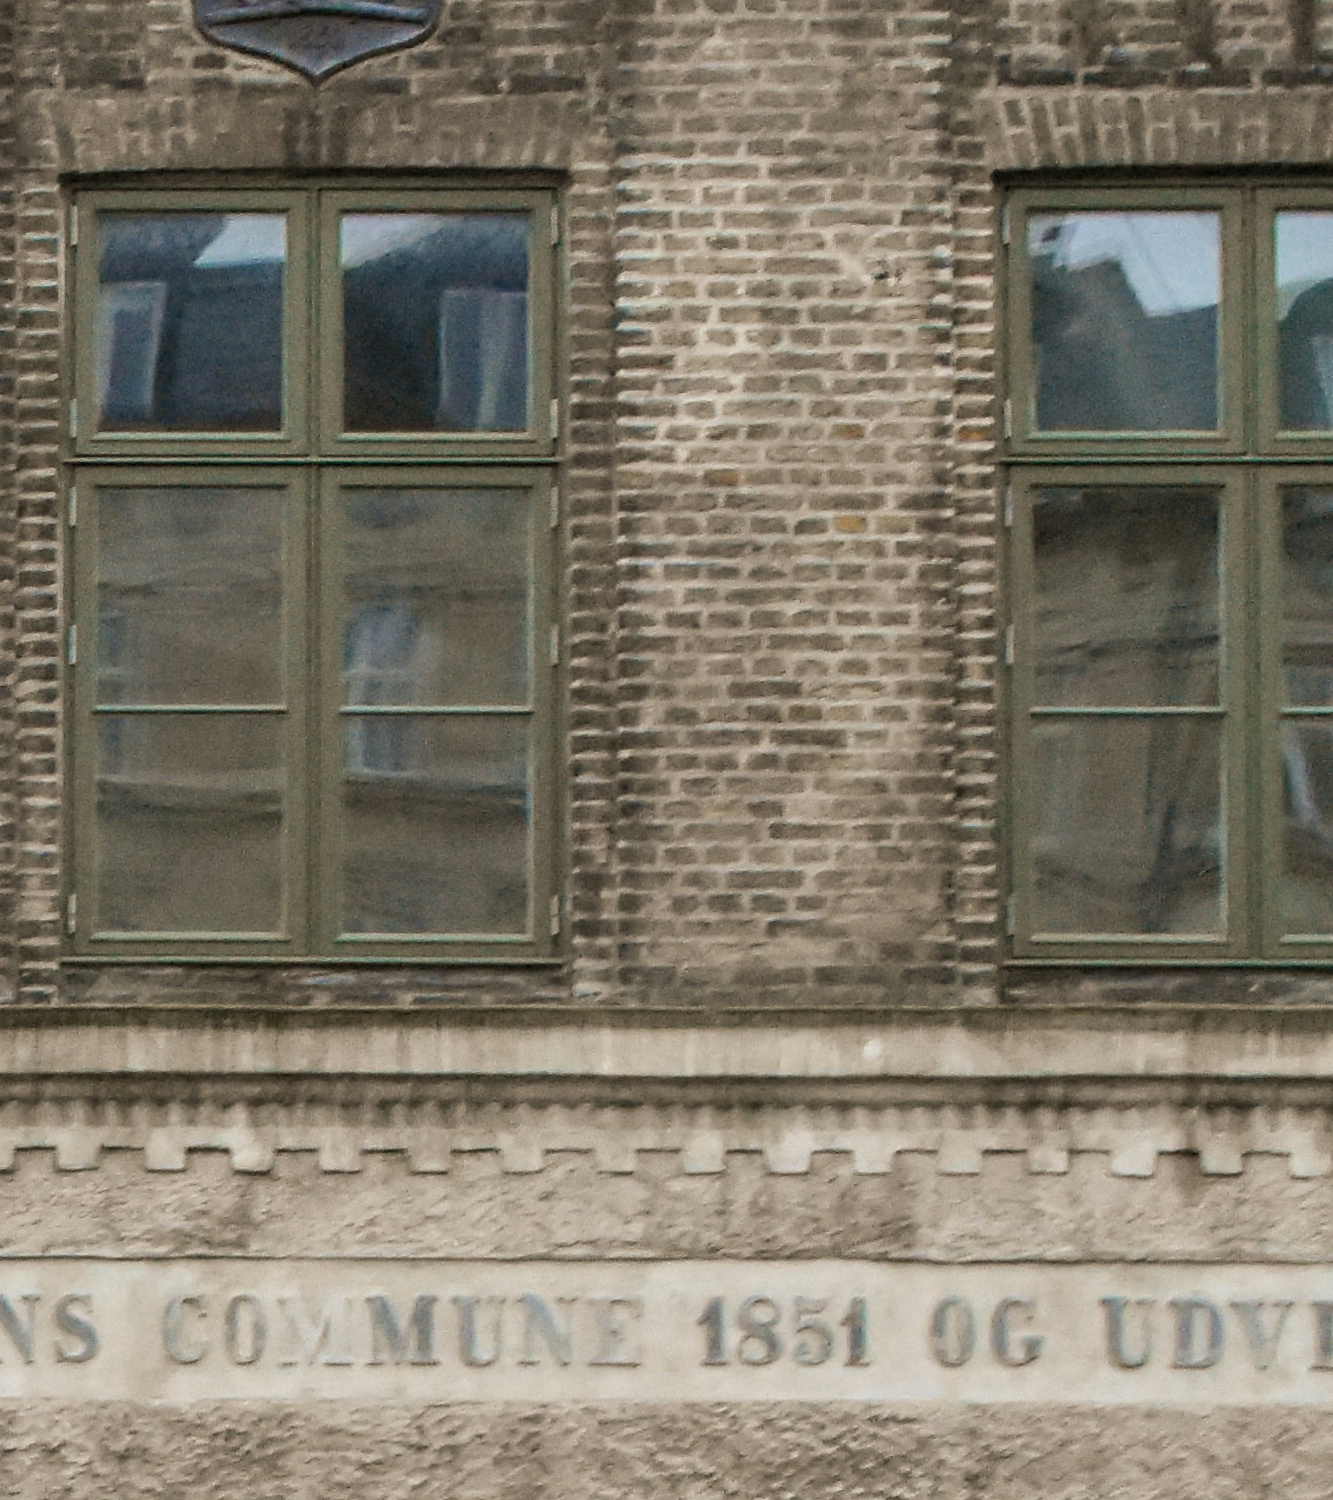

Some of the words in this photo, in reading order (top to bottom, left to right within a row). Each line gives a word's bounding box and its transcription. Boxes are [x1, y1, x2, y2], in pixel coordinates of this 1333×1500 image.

[162, 1293, 643, 1369] COMMUNE
[697, 1295, 872, 1369] 1851
[930, 1295, 1044, 1370] OG
